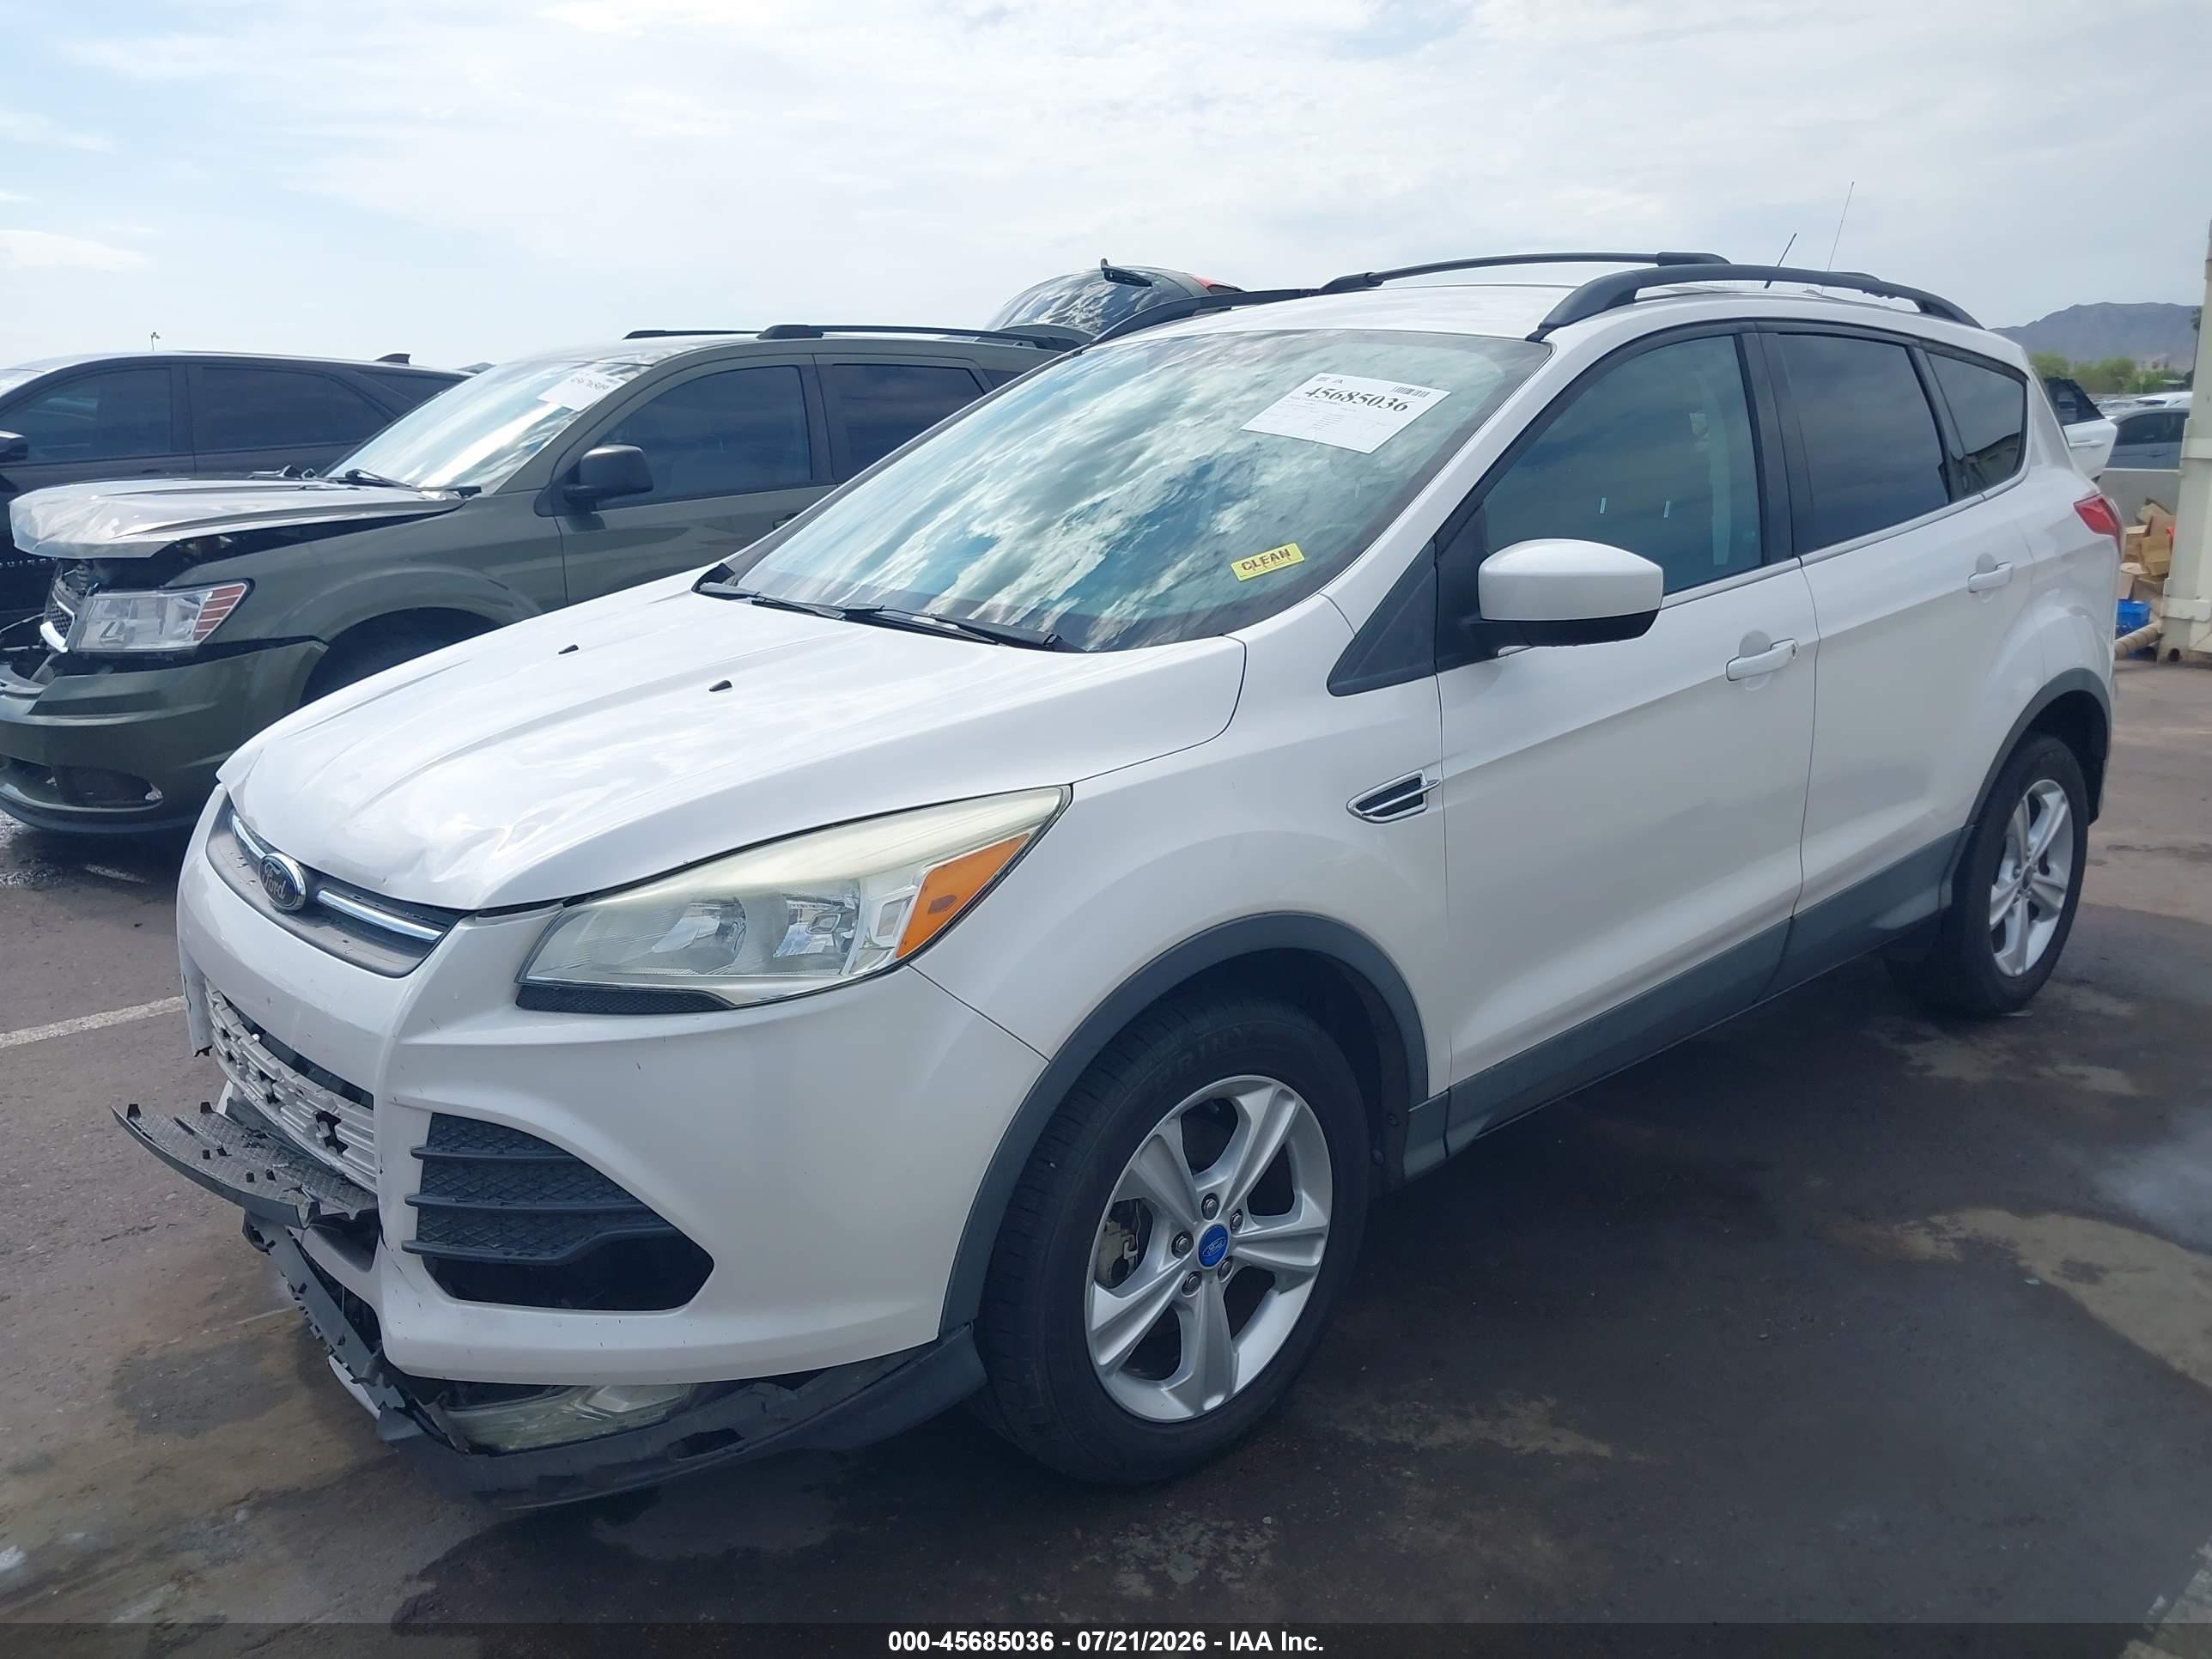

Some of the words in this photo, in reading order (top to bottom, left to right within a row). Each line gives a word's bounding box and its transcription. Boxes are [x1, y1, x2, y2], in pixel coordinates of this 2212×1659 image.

[1304, 386, 1416, 413] 45685036
[1241, 548, 1291, 571] CLEAN
[261, 860, 289, 901] Ford
